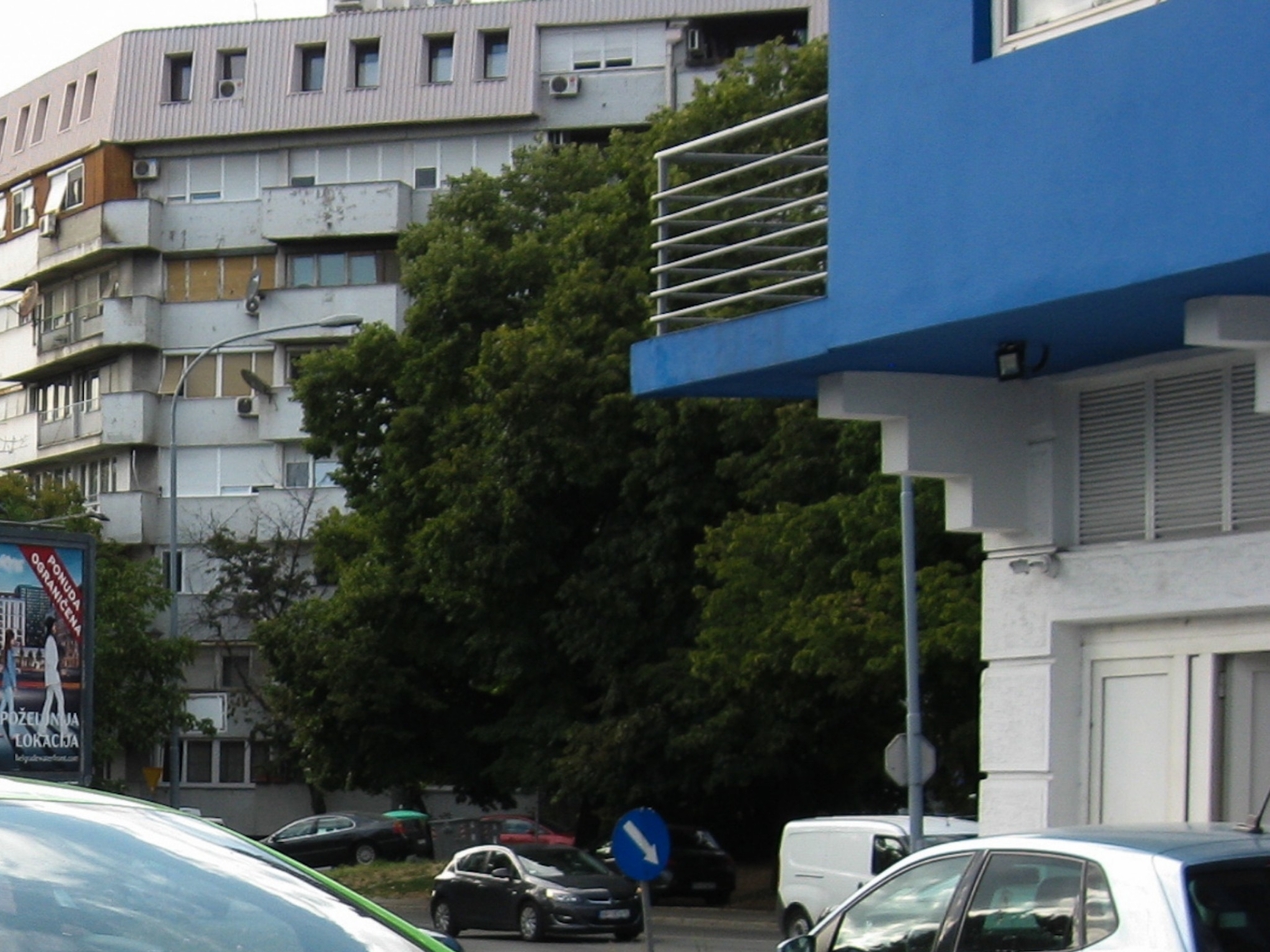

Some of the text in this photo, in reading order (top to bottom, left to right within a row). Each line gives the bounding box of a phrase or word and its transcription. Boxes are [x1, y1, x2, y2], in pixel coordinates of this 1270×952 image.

[31, 552, 82, 637] OGRANIČENA
[47, 554, 81, 611] PONUDA
[15, 732, 79, 748] LOKACIJA
